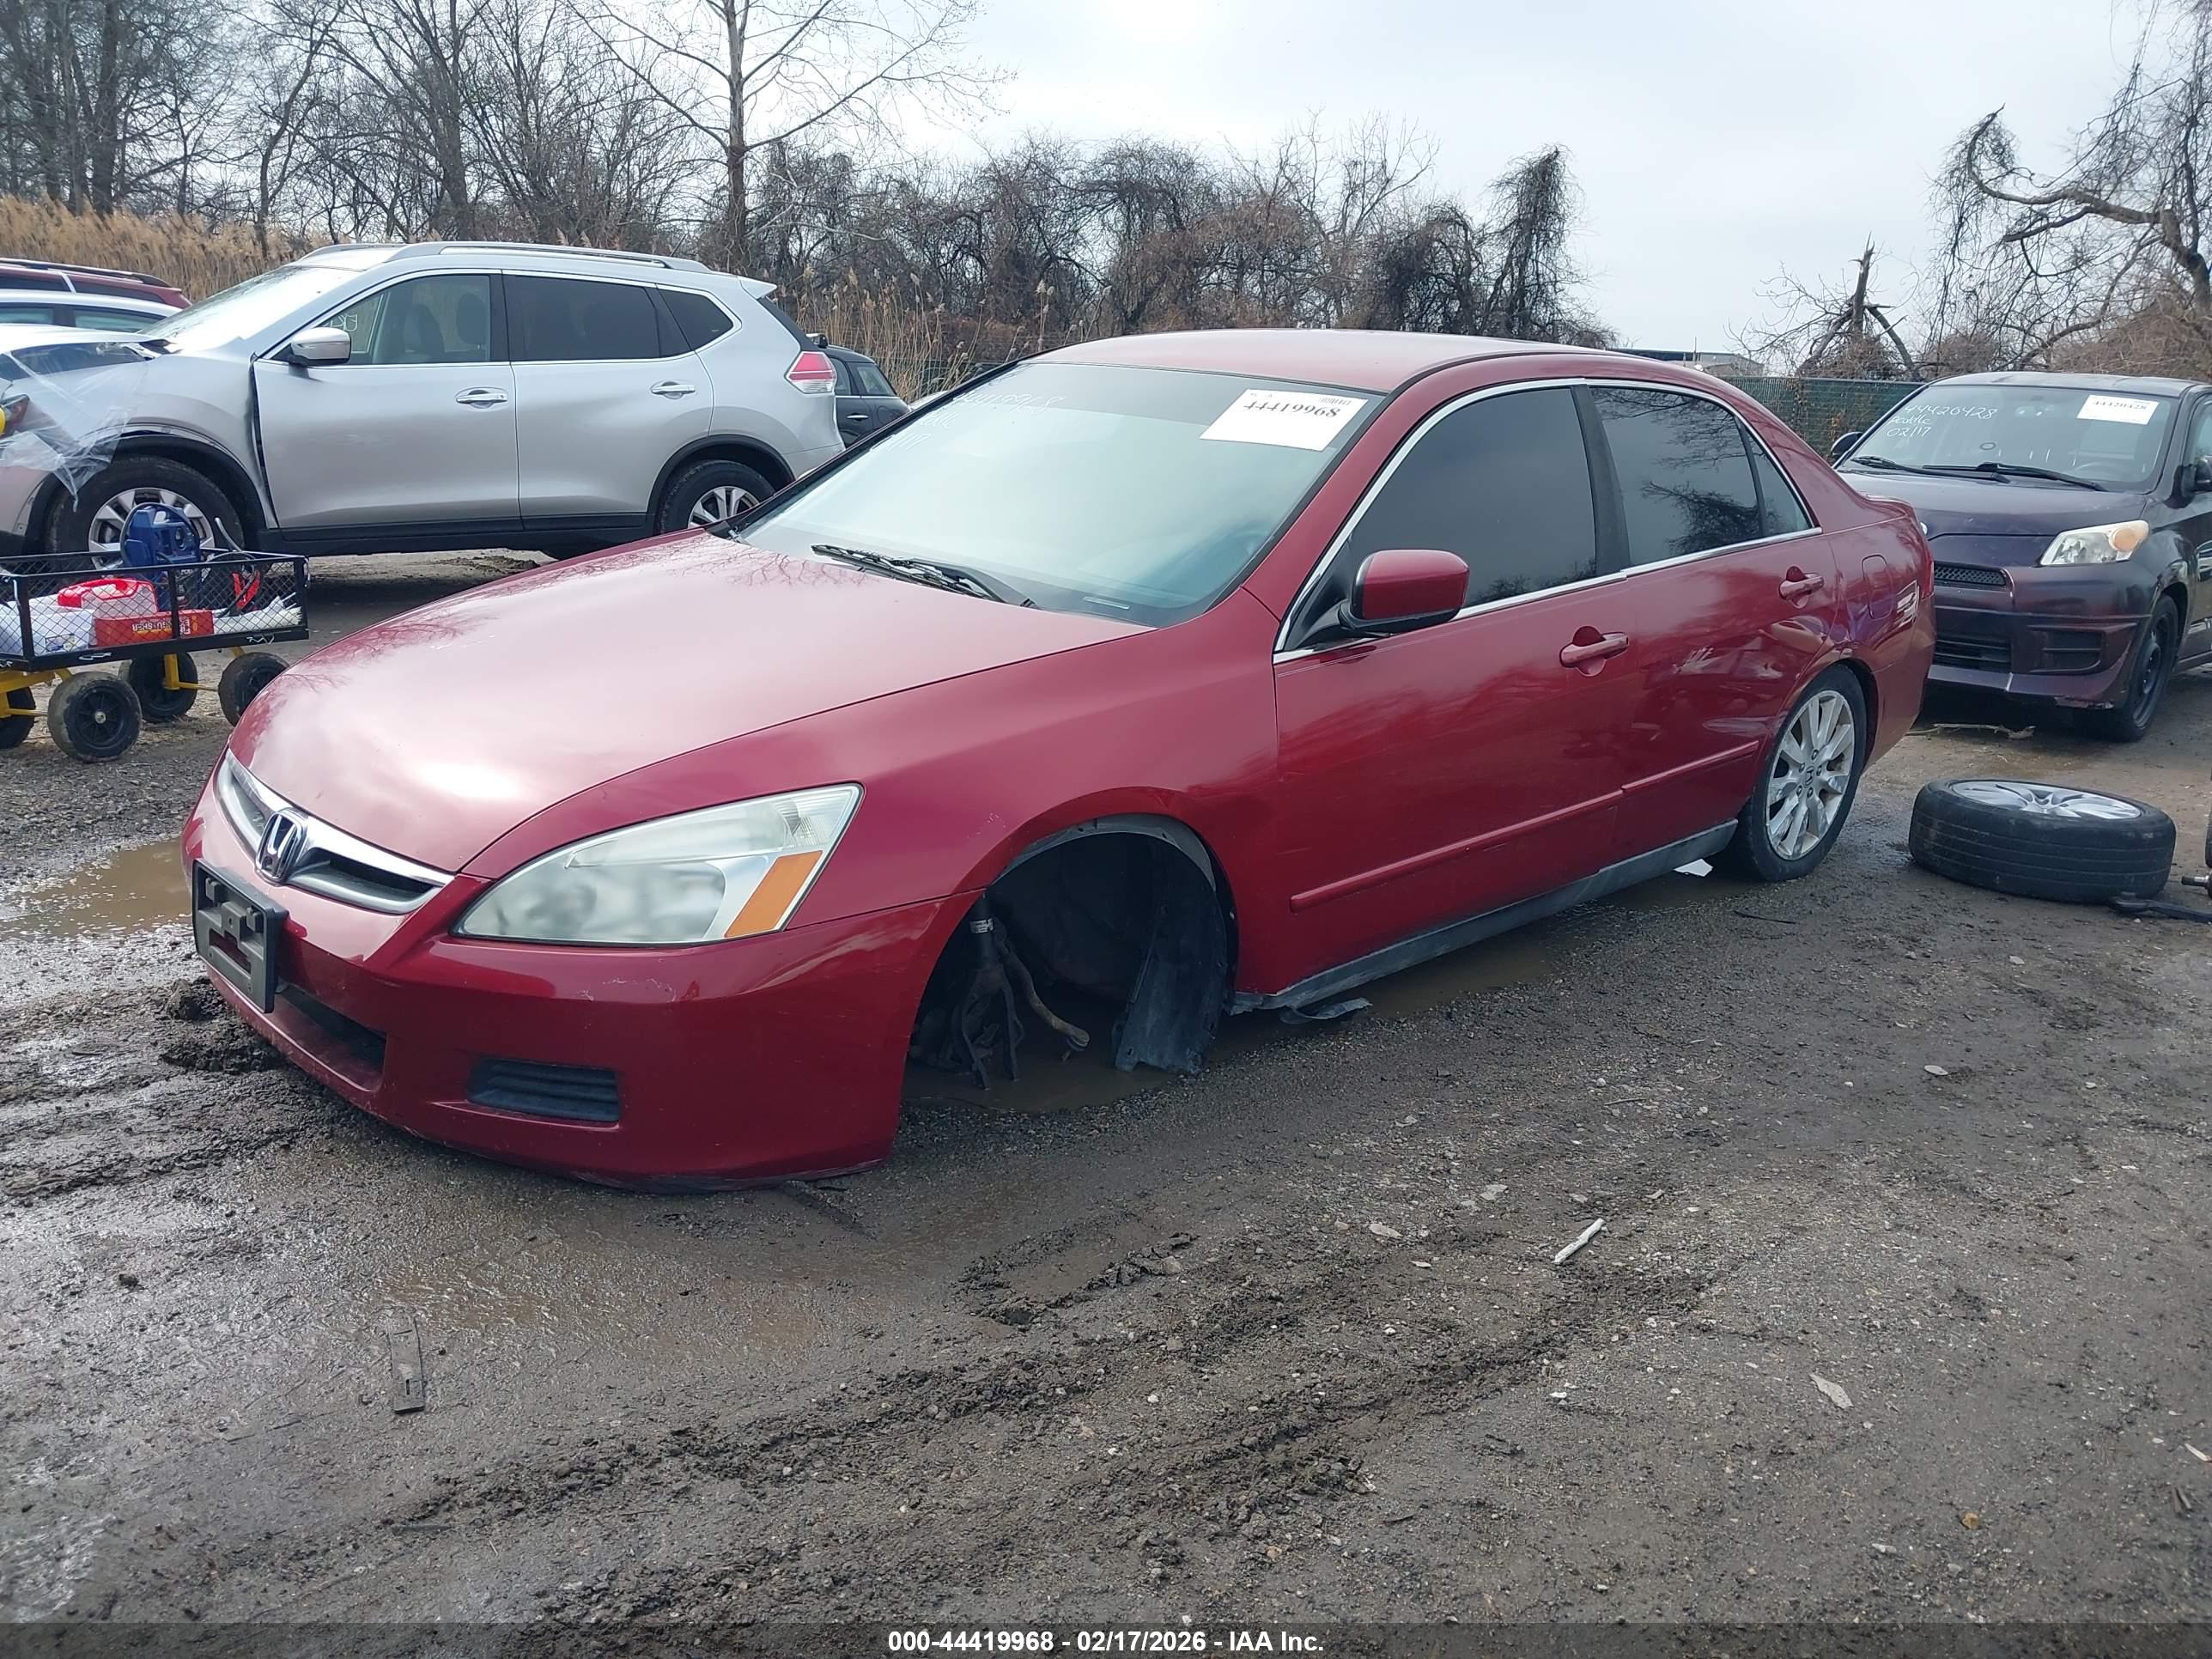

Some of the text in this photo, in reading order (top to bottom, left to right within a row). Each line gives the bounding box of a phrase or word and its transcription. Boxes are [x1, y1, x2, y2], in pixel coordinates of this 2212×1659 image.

[1243, 401, 1340, 417] 44419968
[1905, 404, 1998, 420] 44420428
[1887, 426, 1931, 437] 02/17
